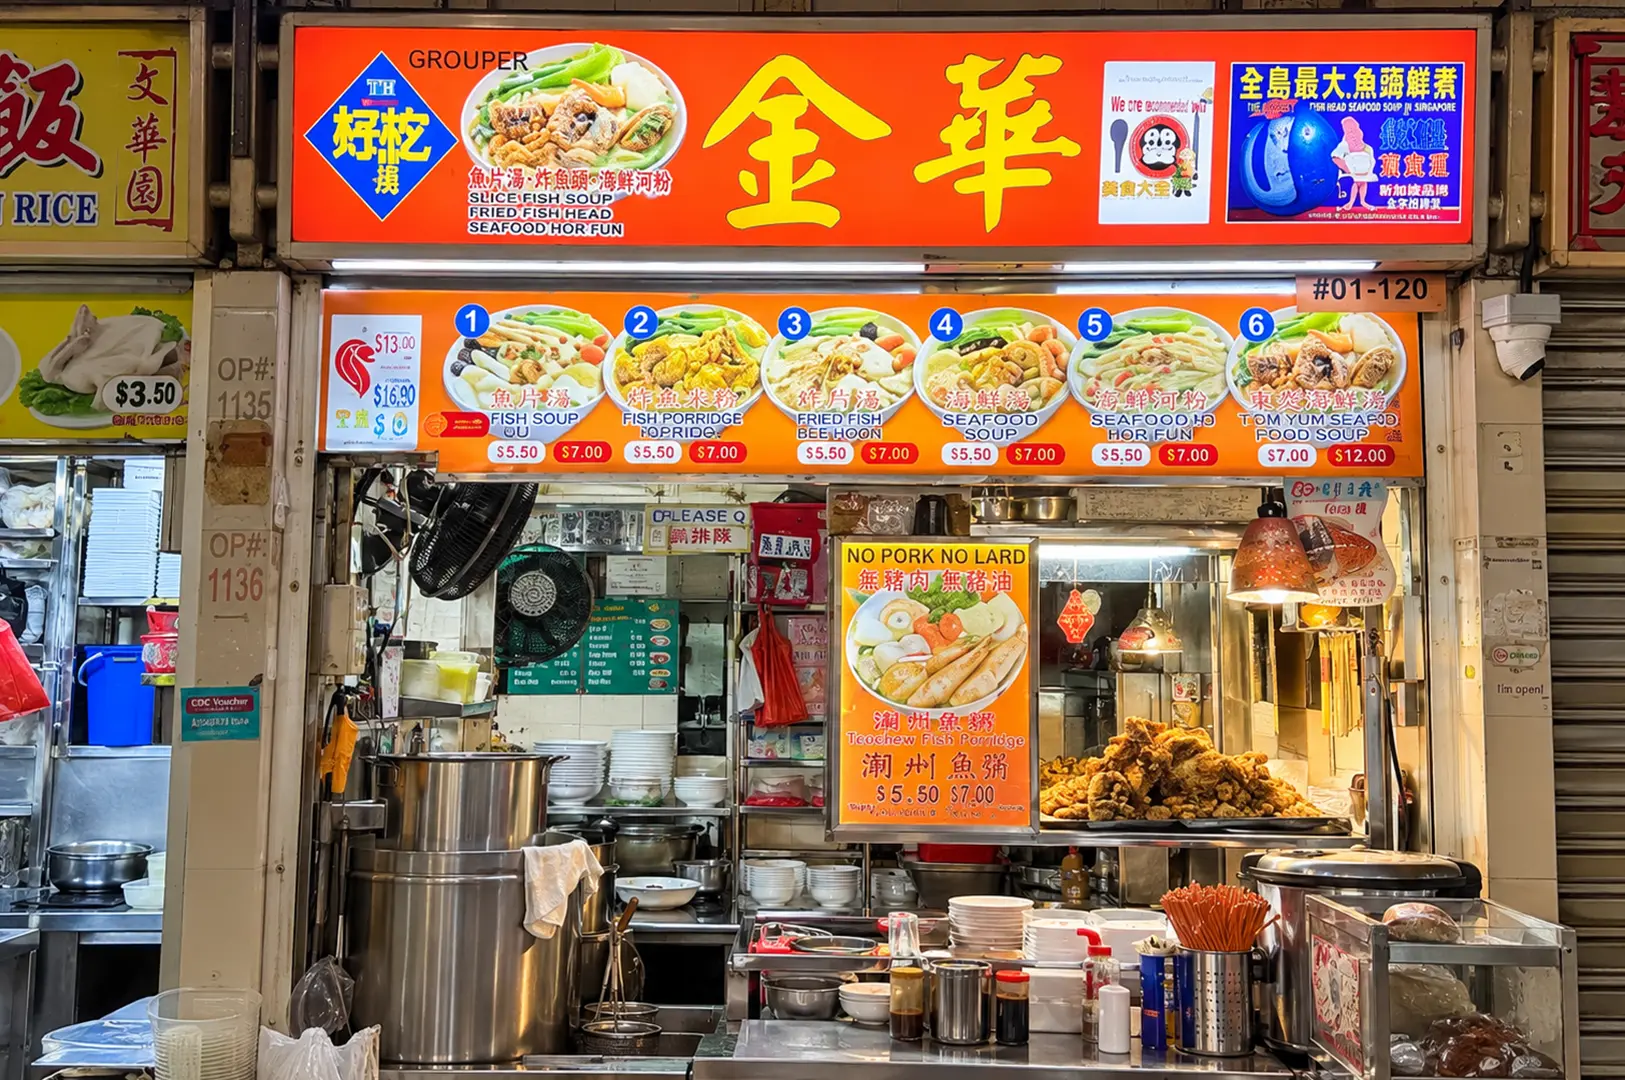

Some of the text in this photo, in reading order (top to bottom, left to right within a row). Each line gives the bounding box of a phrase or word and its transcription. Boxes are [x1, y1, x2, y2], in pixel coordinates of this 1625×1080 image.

[408, 50, 529, 71] GROUPER
[366, 79, 396, 96] TH
[1111, 96, 1125, 112] We
[125, 63, 168, 214] 文華園
[702, 54, 1081, 233] 金華
[470, 193, 612, 205] SLICE FISH SOUP
[14, 194, 97, 224] RICE
[470, 207, 612, 220] FRIED FISH HEAD
[470, 222, 622, 235] SEAFOOD HOR FUN
[1312, 277, 1428, 300] #01-120
[465, 309, 476, 332] 1
[632, 311, 649, 333] 2
[786, 312, 803, 334] 3
[940, 313, 954, 335] 4
[1087, 314, 1102, 336] 5
[1248, 314, 1264, 335] 6
[217, 357, 275, 381] OP#:
[116, 380, 176, 407] $3.50
[217, 390, 272, 420] 1135
[491, 413, 527, 425] FISH
[533, 413, 579, 425] SOUP
[623, 413, 742, 425] FISH PORRIDGE
[798, 413, 882, 425] FRIED FISH
[943, 414, 1038, 426] SEAFOOD
[1091, 414, 1188, 426] SEAFOOD
[1239, 413, 1281, 426] TOM
[1285, 413, 1324, 425] YUM
[798, 427, 882, 439] BEE HOON
[964, 428, 1018, 440] SOUP
[1108, 429, 1192, 440] HOR FUN
[1316, 429, 1369, 441] SOUP
[497, 445, 538, 459] $5.50
[562, 445, 603, 459] $7.00
[634, 445, 675, 459] $5.50
[698, 446, 738, 459] $7.00
[806, 446, 847, 459] $5.50
[870, 446, 909, 460] $7.00
[951, 447, 992, 461] $5.50
[1014, 447, 1056, 461] $7.00
[1101, 448, 1143, 462] $5.50
[1167, 448, 1209, 462] $7.00
[1267, 449, 1309, 462] $7.00
[1335, 448, 1387, 462] $12.00
[733, 510, 746, 524] Q
[209, 532, 267, 559] OP#:
[847, 548, 1026, 565] NO PORK NO LARD
[208, 567, 264, 602] 1136
[922, 733, 953, 746] Fish
[876, 784, 994, 804] $5.50 $7.00
